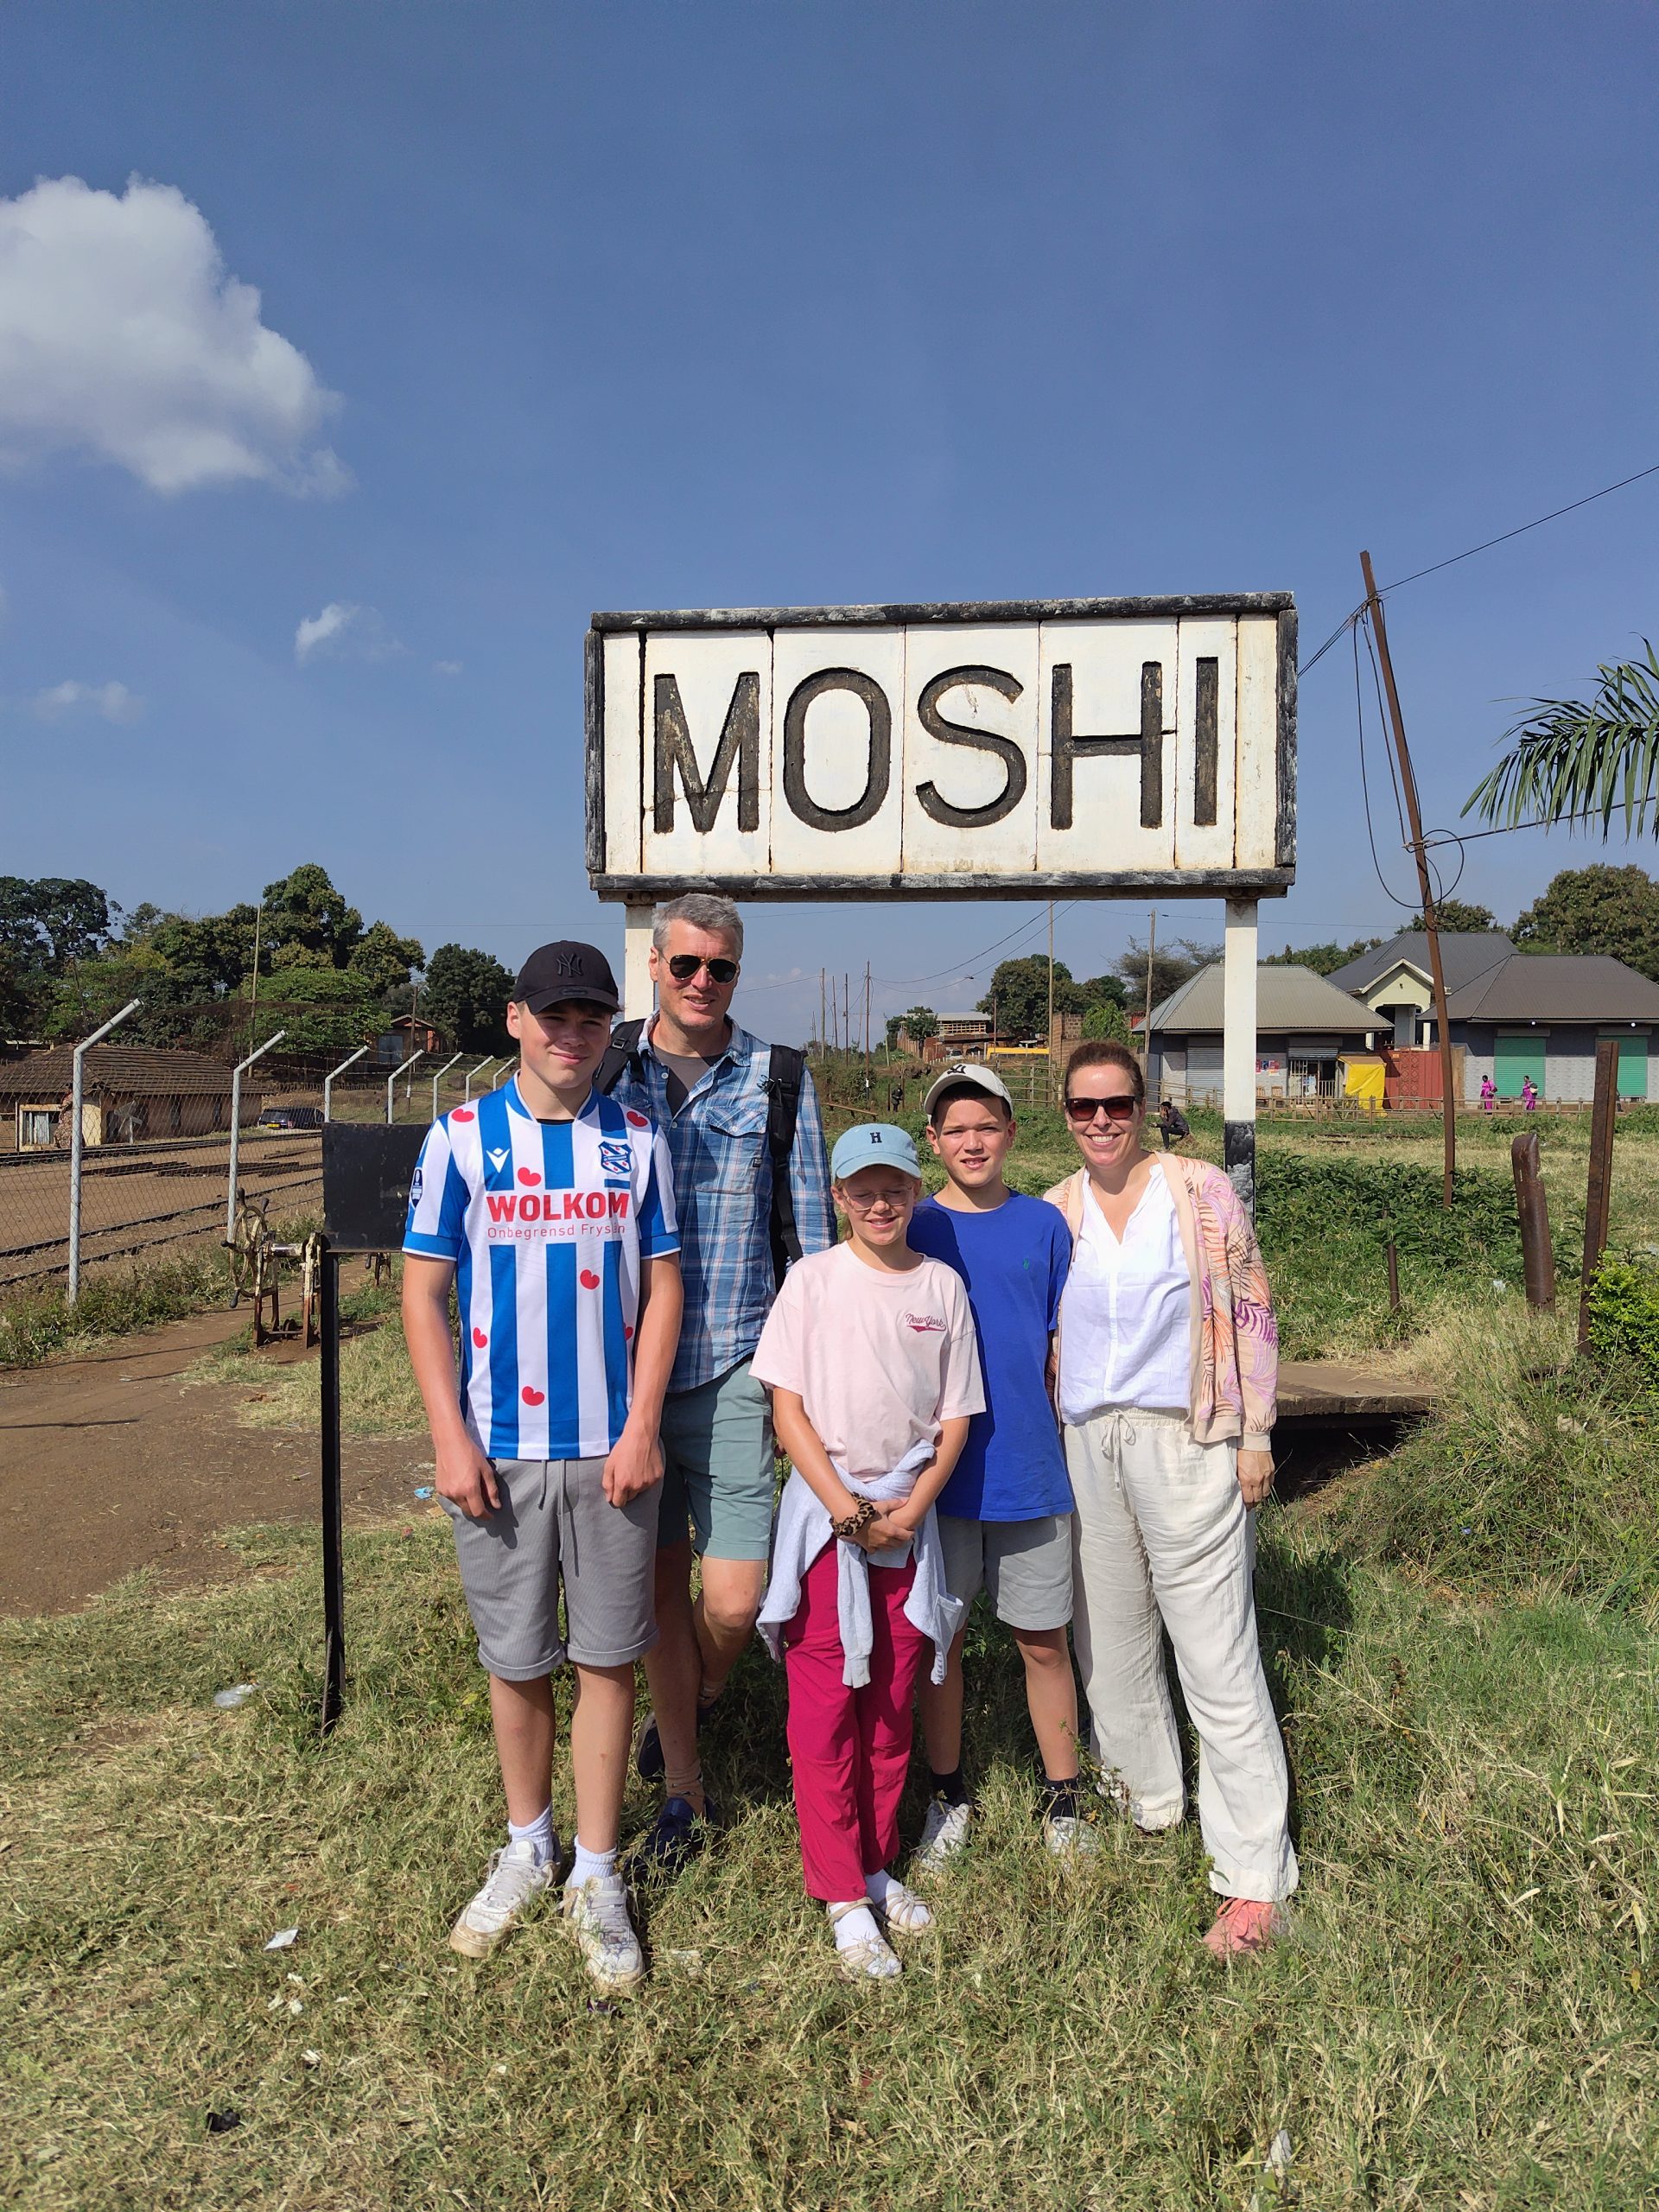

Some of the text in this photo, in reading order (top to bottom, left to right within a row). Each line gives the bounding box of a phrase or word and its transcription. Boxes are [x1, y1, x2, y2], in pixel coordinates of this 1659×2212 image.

[652, 656, 1219, 834] MOSHI
[869, 1132, 883, 1144] H
[486, 1192, 630, 1223] WOLKOM
[487, 1224, 575, 1241] Onbegrensd
[905, 1313, 945, 1328] New York
